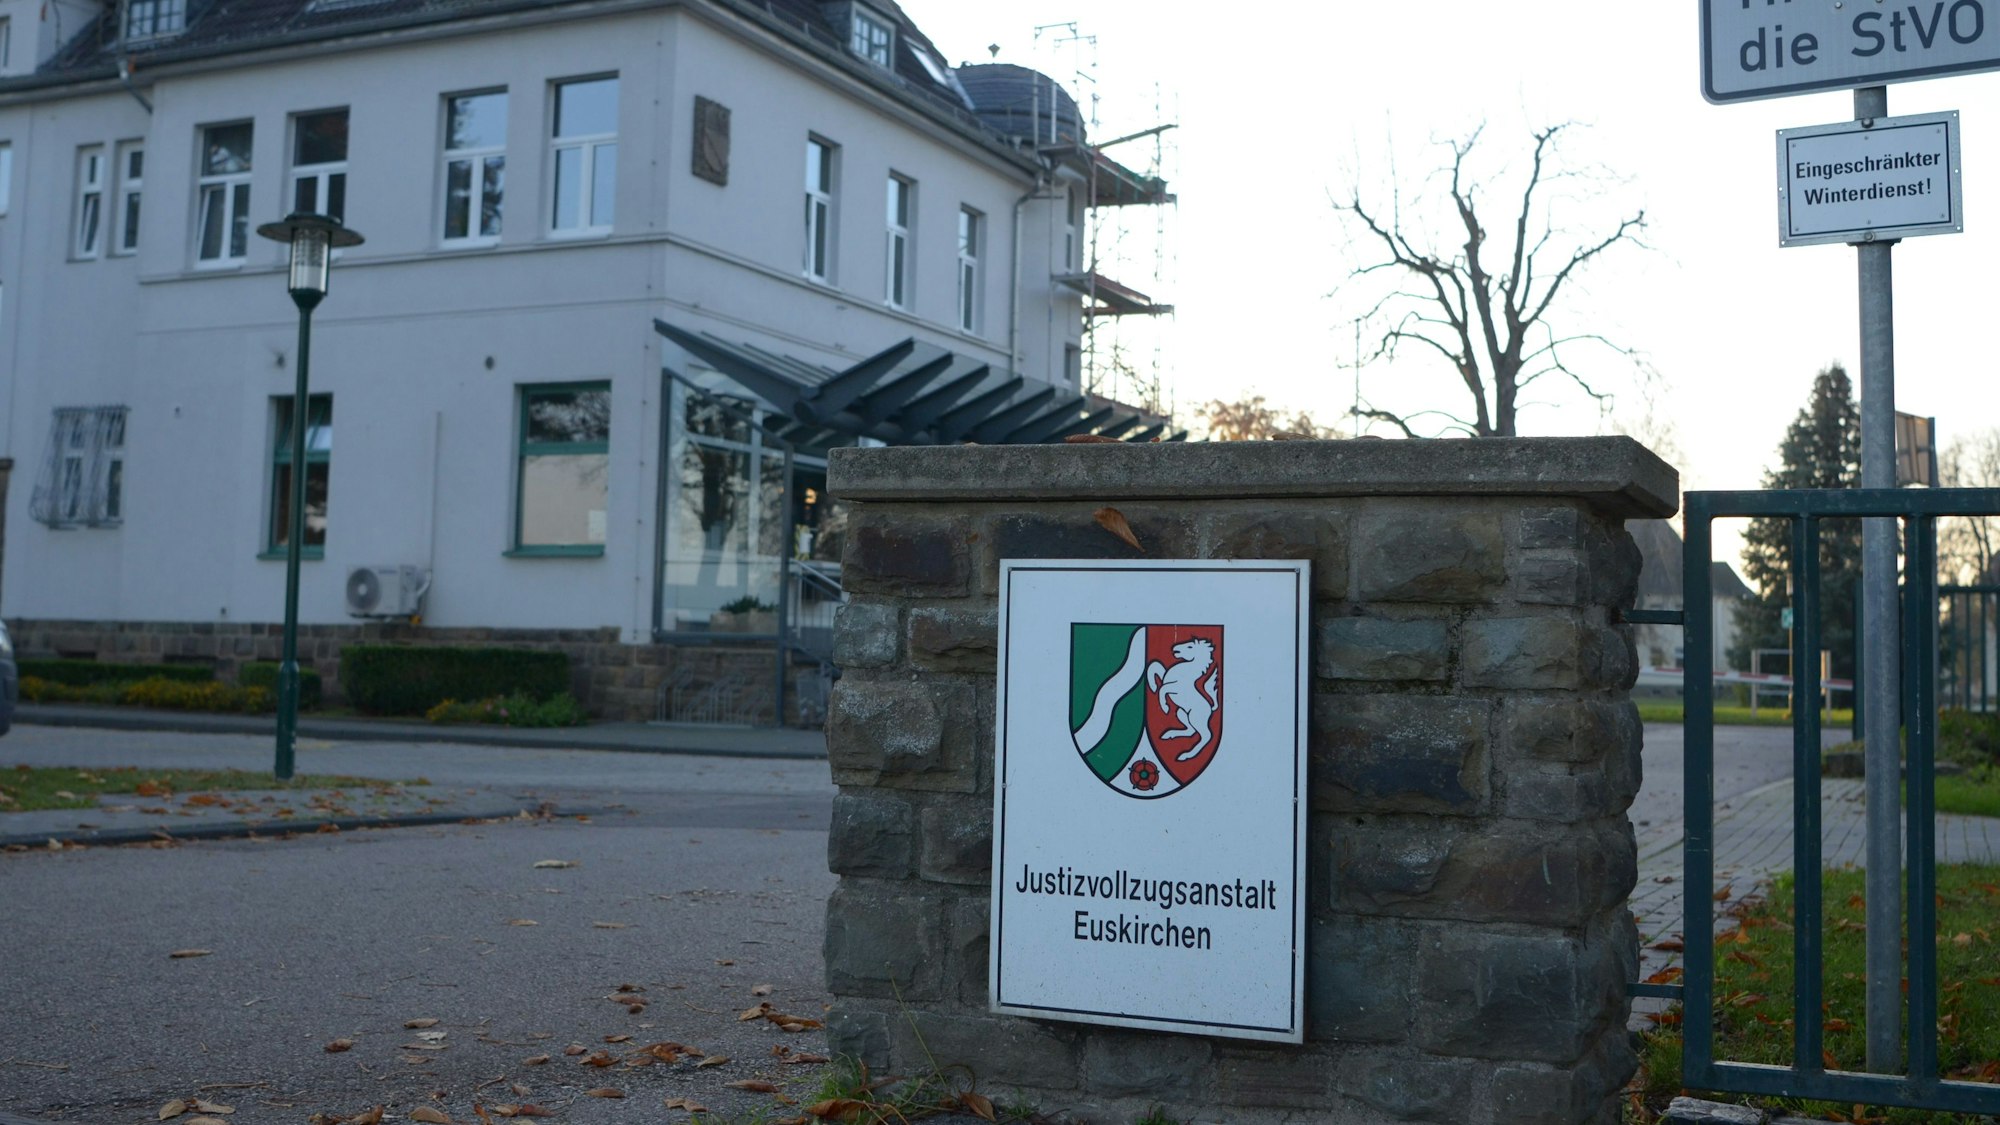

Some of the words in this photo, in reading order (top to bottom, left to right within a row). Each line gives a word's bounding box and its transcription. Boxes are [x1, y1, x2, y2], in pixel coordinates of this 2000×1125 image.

[1739, 24, 1819, 73] die
[1850, 0, 1985, 58] StVO
[1795, 151, 1942, 181] Eingeschränkter
[1803, 177, 1932, 206] Winterdienst!
[1015, 863, 1277, 910] Justizvollzugsanstalt
[1074, 910, 1211, 950] Euskirchen
